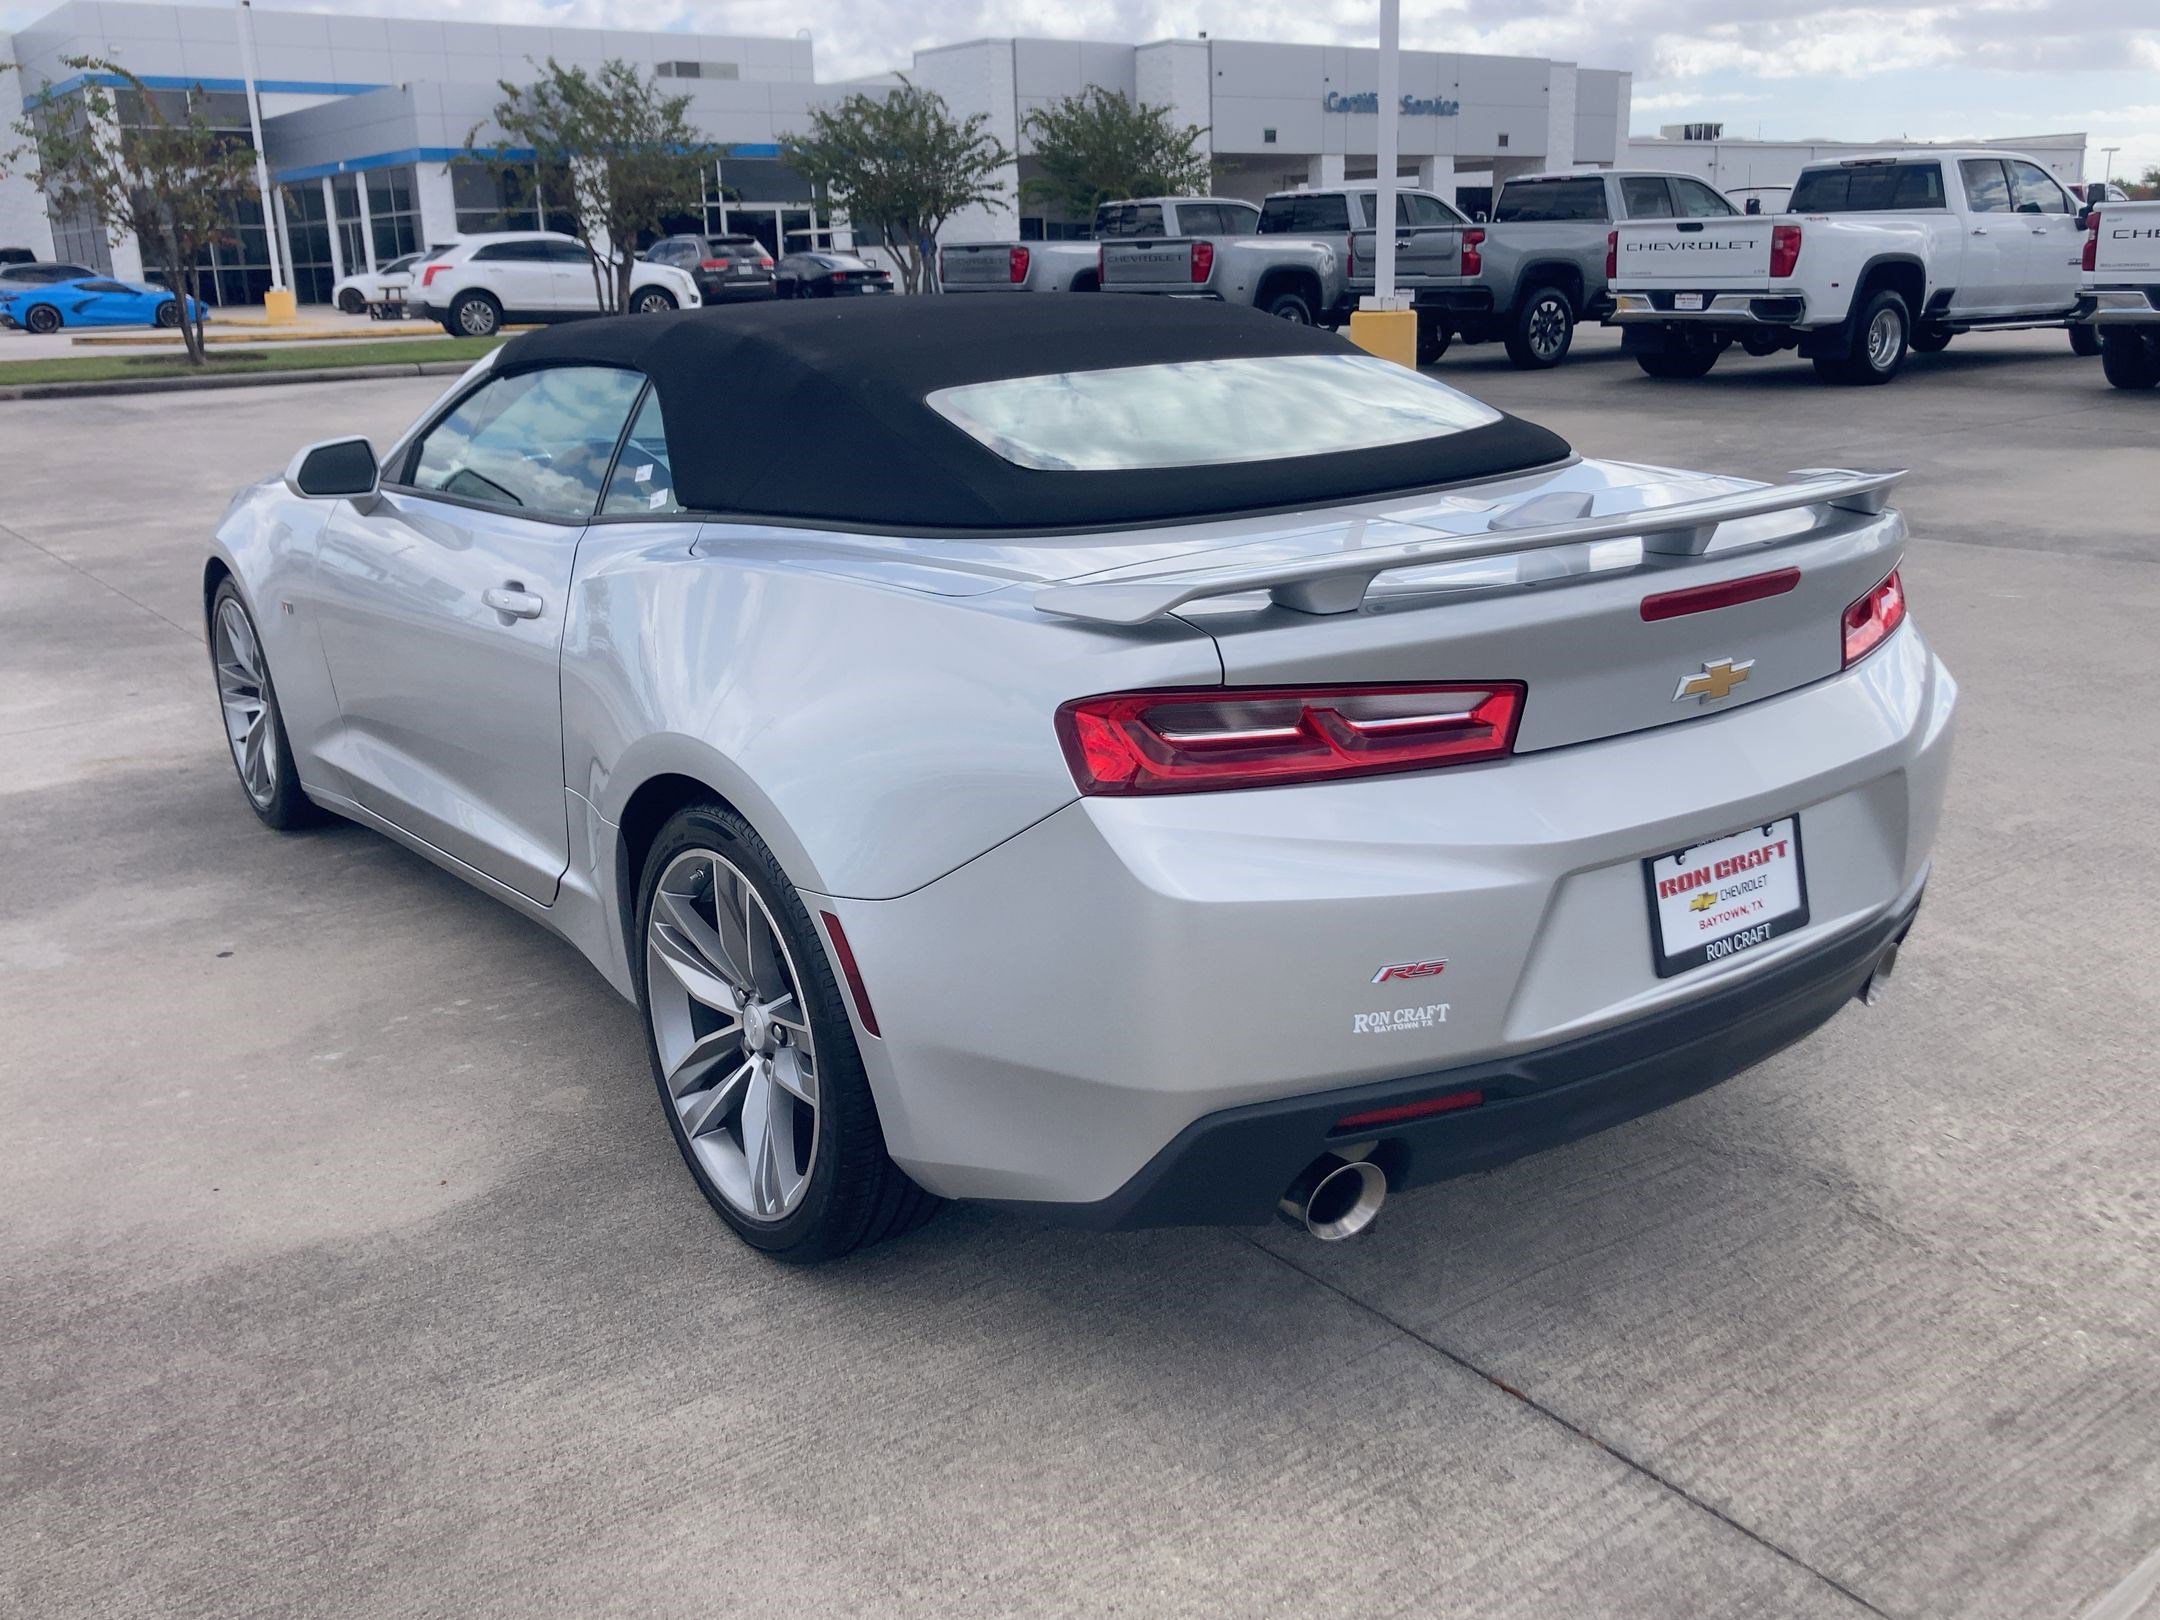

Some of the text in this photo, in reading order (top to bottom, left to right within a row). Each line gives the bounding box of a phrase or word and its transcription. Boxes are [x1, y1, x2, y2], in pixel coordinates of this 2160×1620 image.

[1400, 94, 1459, 116] Service
[1626, 240, 1759, 252] CHEVROLET
[1659, 866, 1711, 899] RON
[1714, 840, 1788, 880] CRAFT
[1720, 874, 1768, 901] CHEVROLET
[1699, 899, 1764, 929] BAYTOWN, TX
[1705, 922, 1772, 961] RON CRAFT
[1370, 958, 1449, 983] RS
[1353, 1003, 1450, 1033] RON CRAFT
[1374, 1019, 1433, 1033] BAYTOWN TX
